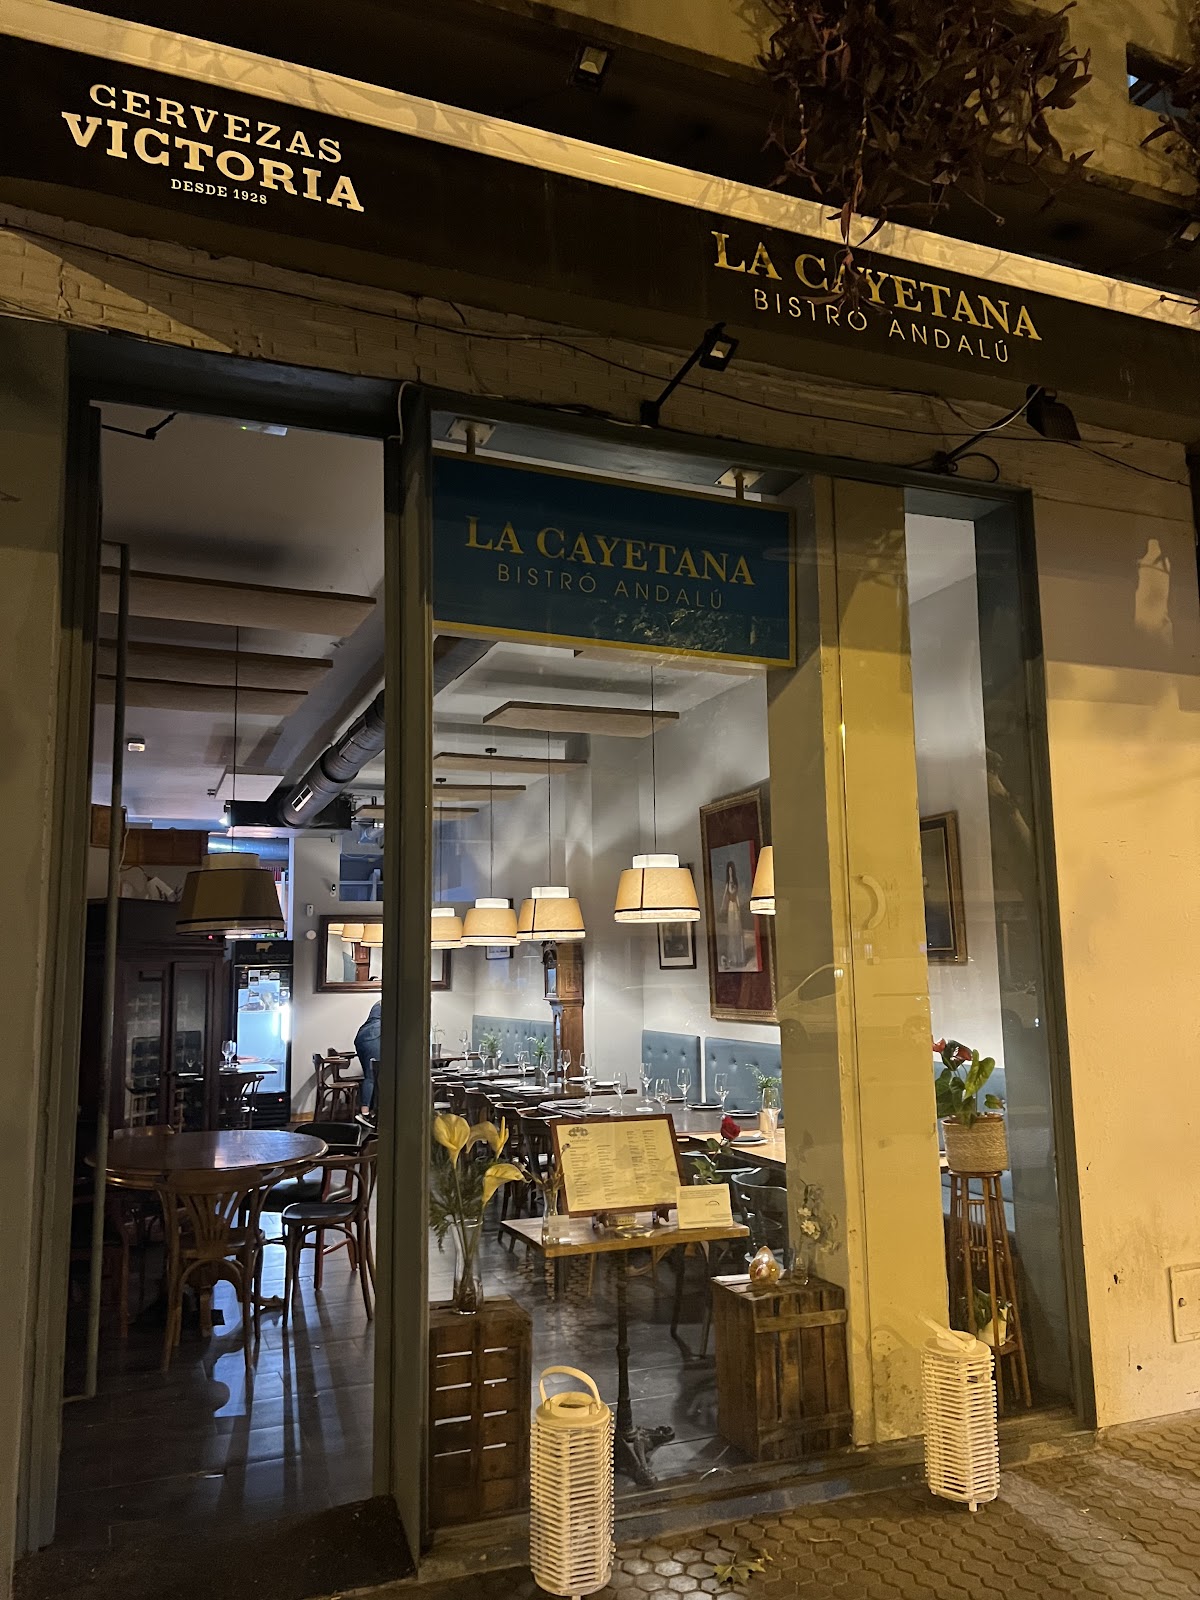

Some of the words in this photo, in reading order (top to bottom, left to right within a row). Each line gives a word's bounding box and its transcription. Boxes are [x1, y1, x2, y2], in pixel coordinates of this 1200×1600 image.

[90, 84, 341, 164] CERVEZAS
[61, 111, 365, 213] VICTORIA
[171, 178, 228, 198] DESDE
[233, 188, 268, 205] 1928
[711, 230, 783, 281] LA
[889, 319, 1009, 363] ANDALÚ
[465, 515, 524, 555] LA
[536, 527, 756, 585] CAYETANA
[498, 563, 596, 593] BISTRÓ
[614, 580, 722, 610] ANDALÚ
